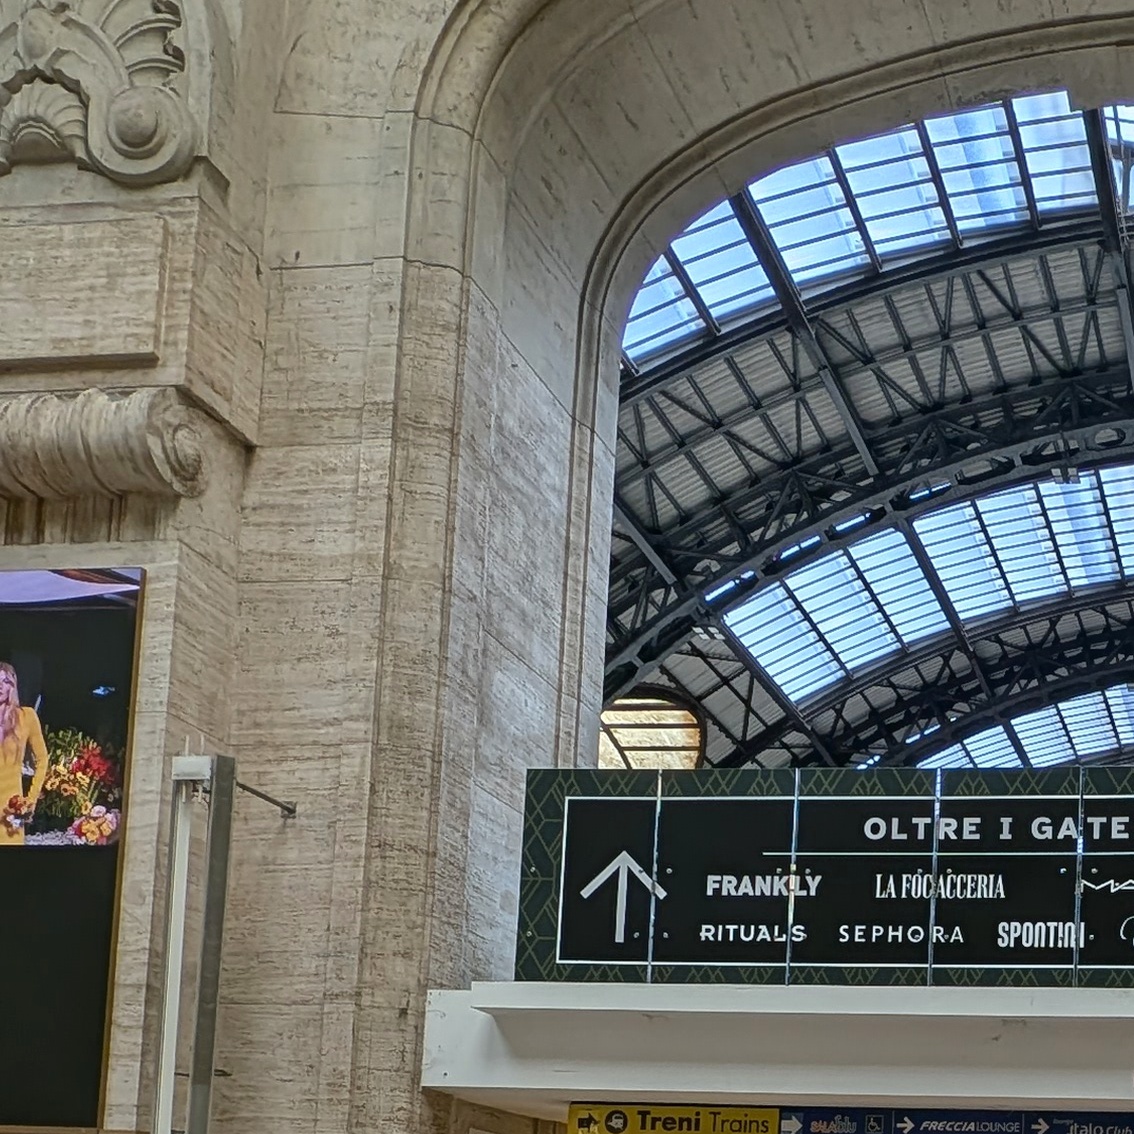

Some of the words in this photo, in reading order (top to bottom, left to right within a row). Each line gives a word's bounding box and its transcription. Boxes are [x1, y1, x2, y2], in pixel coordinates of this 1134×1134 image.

[864, 816, 982, 841] OLTRE
[999, 816, 1014, 841] I
[1030, 816, 1130, 841] GATE
[706, 874, 823, 897] FRANKLY
[875, 874, 898, 899] LA
[901, 873, 1006, 899] FOCACCERIA
[699, 924, 807, 942] RITUALS
[838, 924, 965, 944] SEPHORA
[997, 921, 1086, 949] SPONTINI
[636, 1110, 701, 1132] Treni
[708, 1111, 770, 1134] Trains
